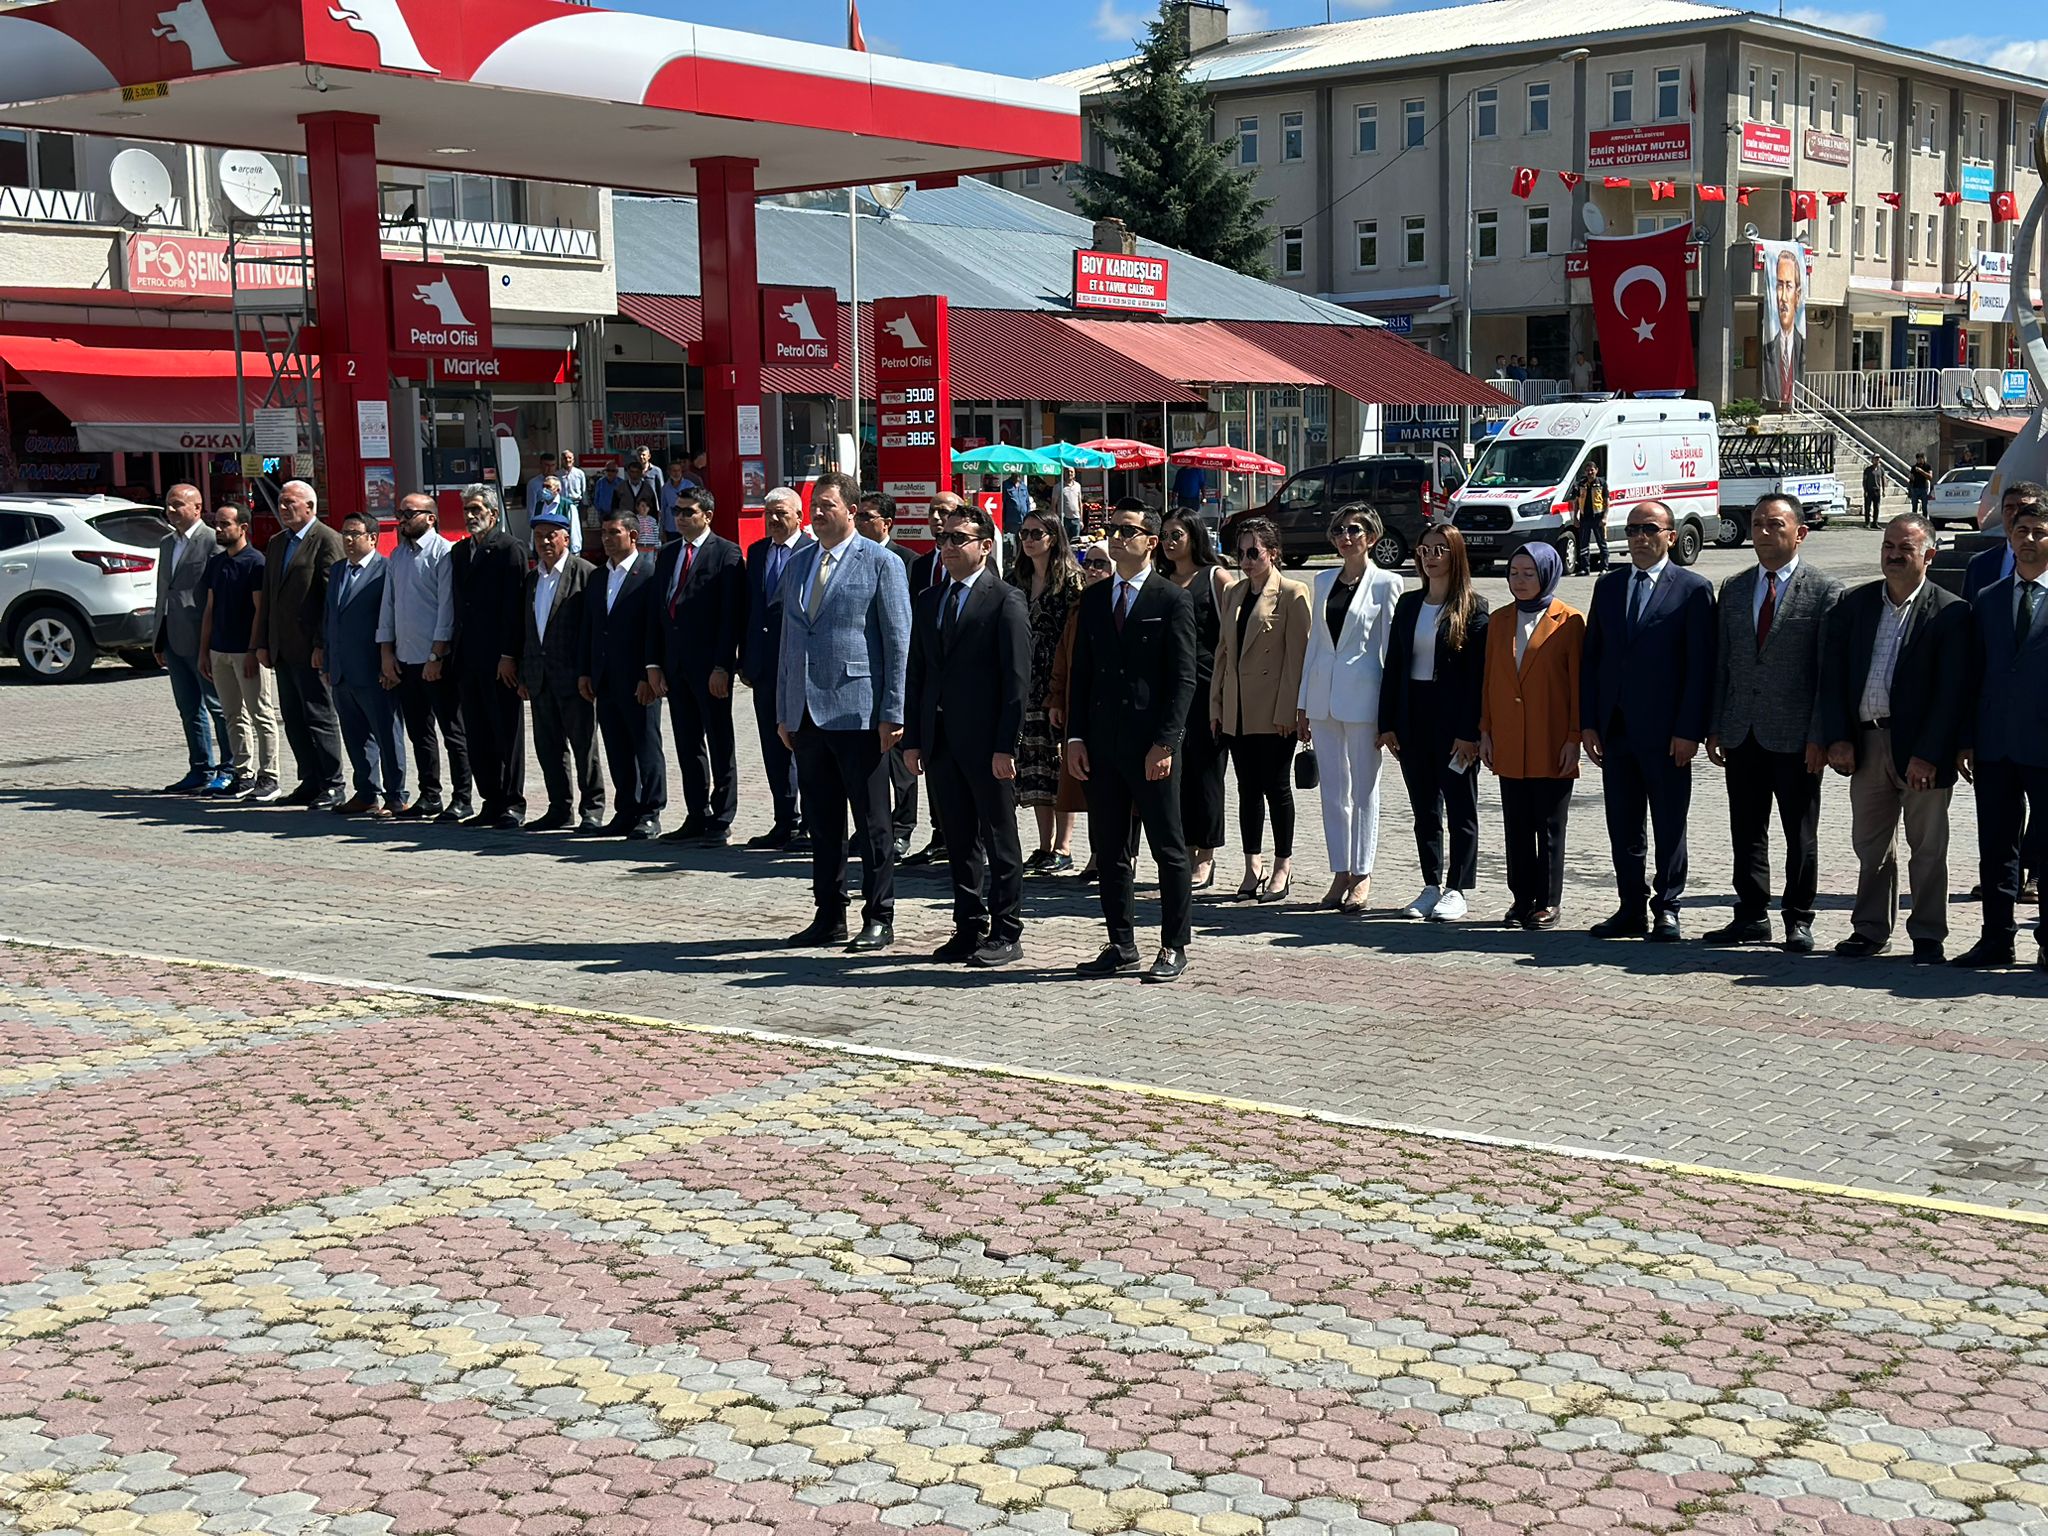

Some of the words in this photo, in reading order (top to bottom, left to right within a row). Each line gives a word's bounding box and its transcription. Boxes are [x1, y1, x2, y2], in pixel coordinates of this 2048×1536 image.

[1590, 144, 1615, 156] EMİR
[1617, 142, 1648, 153] NİHAT
[1650, 140, 1685, 151] MUTLU
[1588, 157, 1614, 167] HALK
[1616, 150, 1688, 164] KÜTÜPHANESİ
[238, 164, 264, 176] arçelik
[187, 247, 272, 289] ŞEMSTTİN
[1081, 255, 1104, 275] BOY
[1106, 258, 1163, 283] KARDEŞLER
[137, 276, 168, 287] PETROL
[168, 278, 187, 289] OFİSİ
[1089, 279, 1098, 291] ET
[1105, 281, 1127, 293] TAVUK
[1979, 296, 2005, 308] TURKCELL
[410, 328, 447, 345] Petrol
[450, 330, 478, 346] Ofisi
[777, 343, 805, 357] Petrol
[806, 344, 828, 358] Ofisi
[347, 360, 356, 376] 2
[443, 358, 500, 376] Market
[881, 357, 909, 368] Petrol
[909, 355, 932, 367] Ofisi
[730, 370, 736, 384] 1
[905, 387, 935, 403] 39.08
[906, 409, 935, 424] 39.12
[1520, 420, 1539, 431] 112
[907, 431, 936, 446] 38.85
[1400, 427, 1459, 440] MARKET
[612, 433, 668, 450] MARKET
[1679, 461, 1696, 478] 112
[1626, 484, 1665, 499] AMBULANS
[897, 525, 922, 535] maxima
